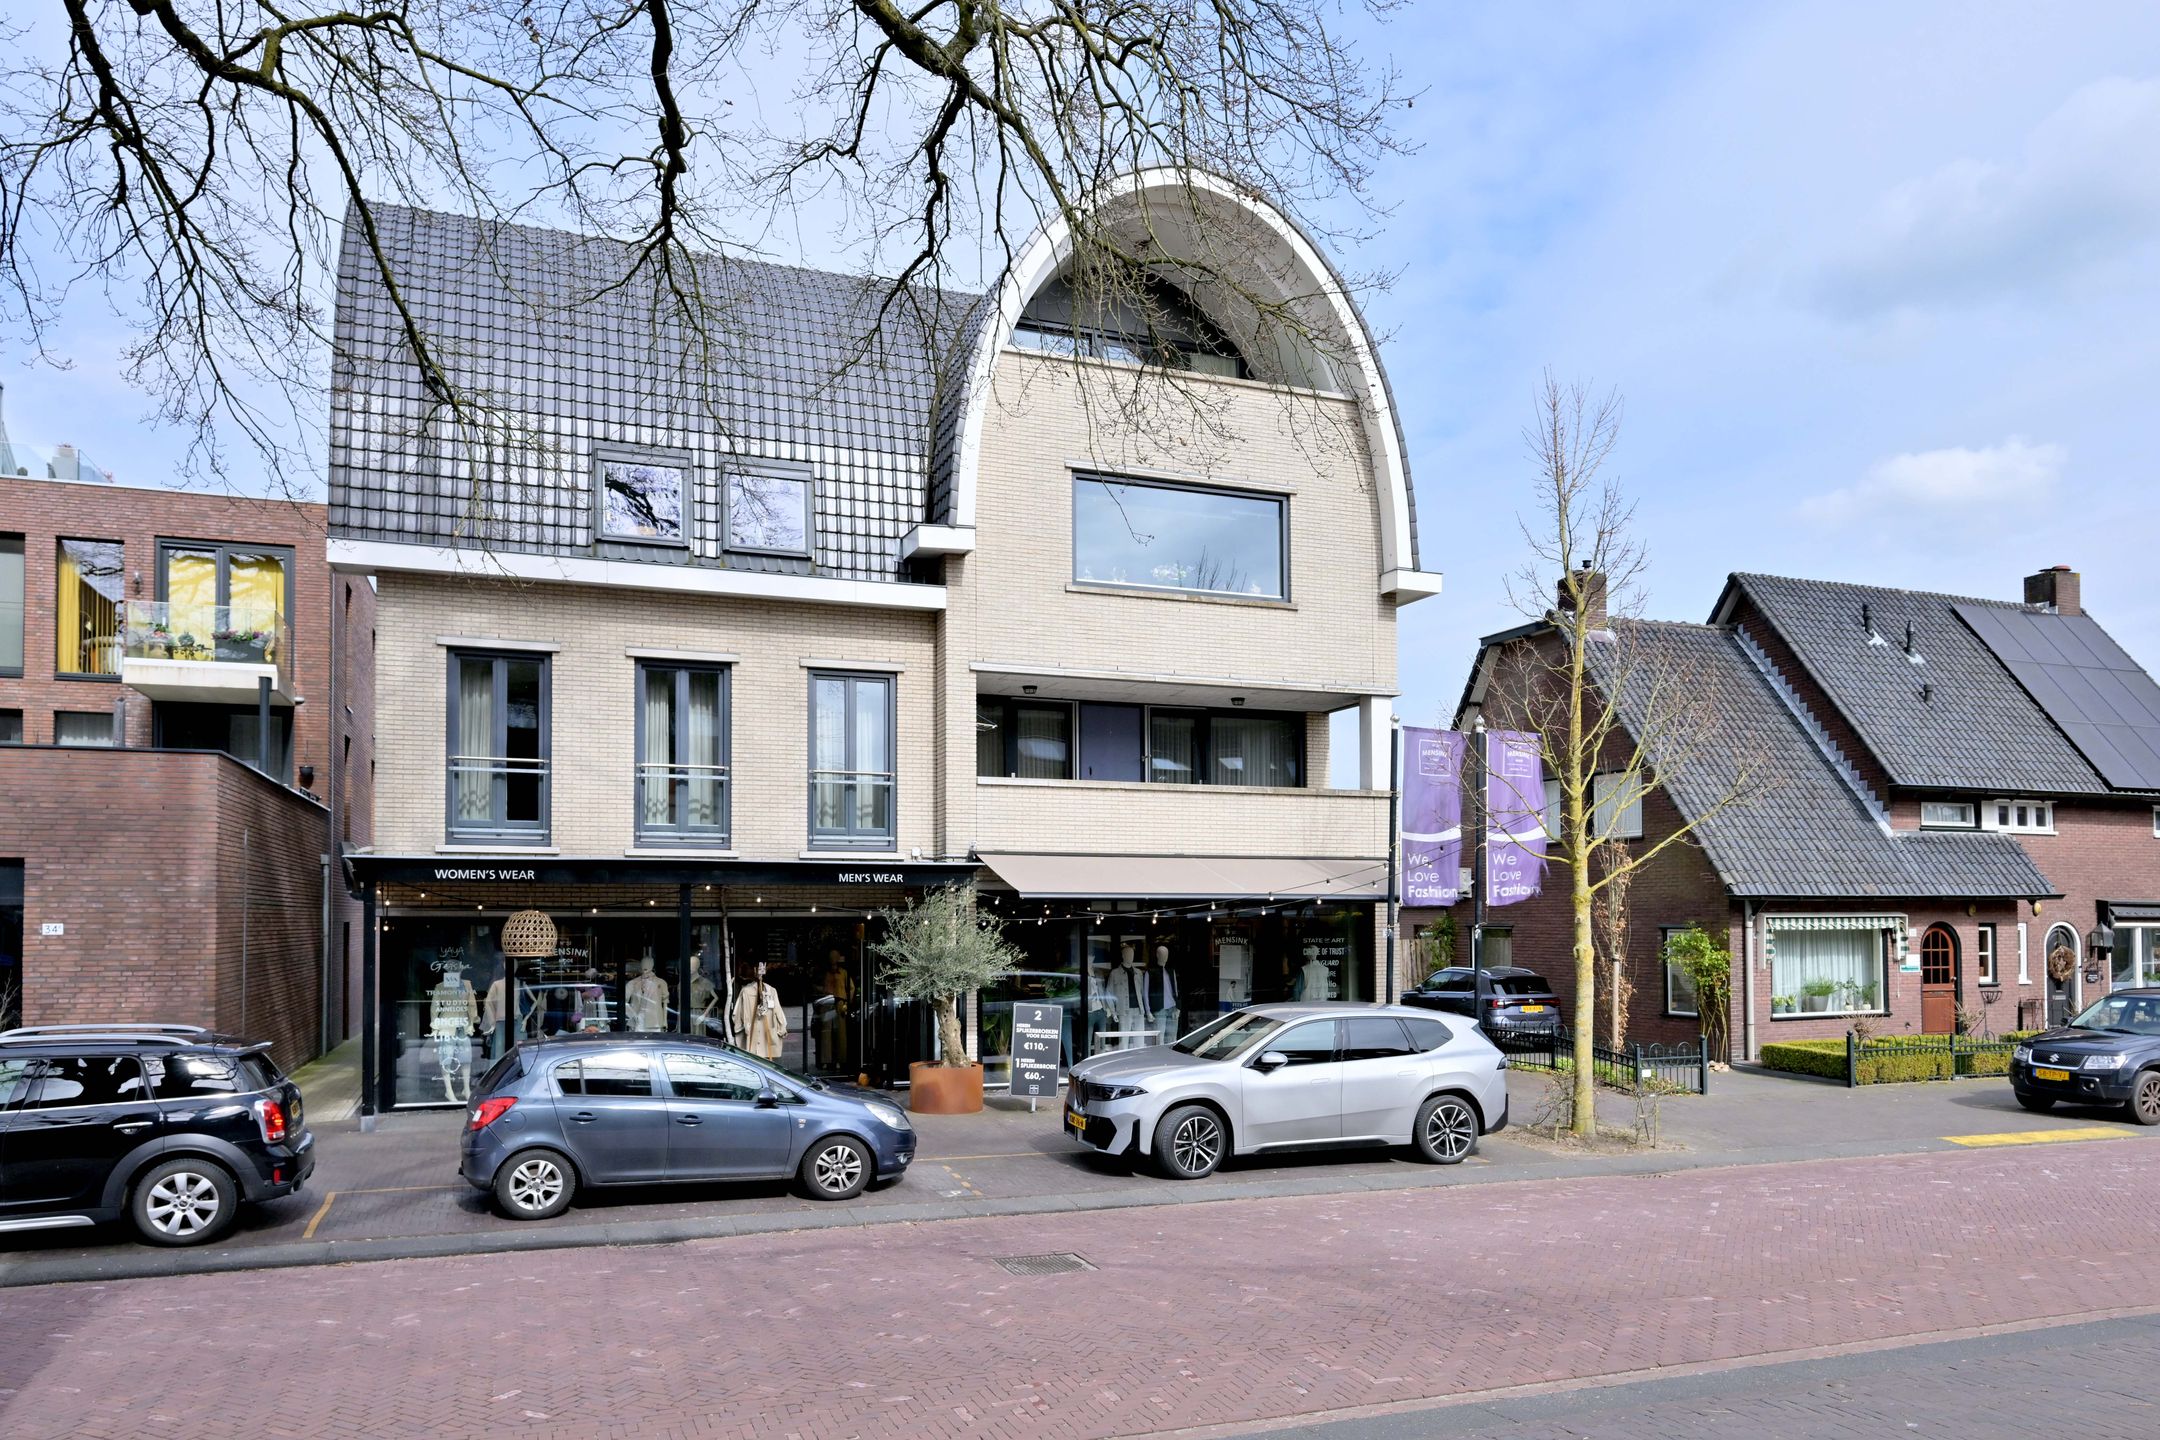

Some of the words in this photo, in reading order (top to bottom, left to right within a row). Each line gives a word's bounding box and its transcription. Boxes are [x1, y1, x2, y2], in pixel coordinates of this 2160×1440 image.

[1407, 853, 1429, 866] We
[1493, 853, 1517, 866] We
[434, 869, 496, 880] WOMEN'S
[499, 870, 535, 880] WEAR
[838, 873, 871, 883] MEN'S
[873, 873, 904, 883] WEAR
[1407, 870, 1440, 883] Love
[1493, 870, 1521, 882] Love
[1407, 885, 1458, 898] Fashion
[548, 948, 589, 958] ENSINK
[1303, 947, 1320, 956] CIRE
[1322, 947, 1328, 956] OF
[1329, 947, 1345, 956] TRUST
[1034, 1010, 1042, 1021] 2
[1023, 1042, 1049, 1051] €110,-
[1024, 1071, 1045, 1081] €60,-
